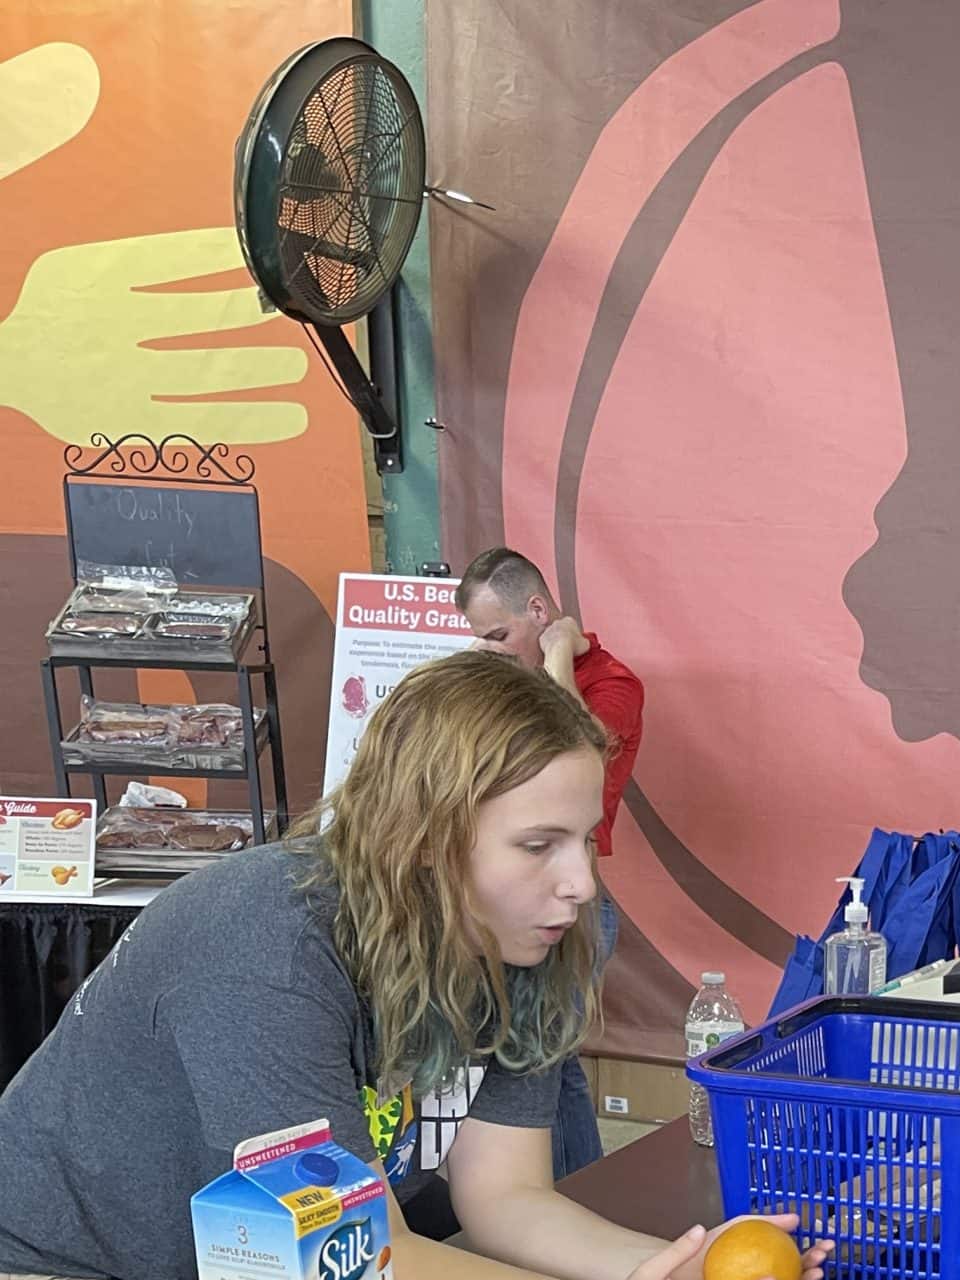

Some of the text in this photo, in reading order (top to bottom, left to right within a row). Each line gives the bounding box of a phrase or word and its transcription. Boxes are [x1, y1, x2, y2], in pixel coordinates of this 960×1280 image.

[384, 583, 420, 602] U.S.
[348, 605, 421, 630] Quality
[239, 1143, 296, 1169] UNSWEETENED
[295, 1190, 325, 1208] NEW
[237, 1225, 249, 1245] 3
[211, 1244, 280, 1263] SIMPLE REASONS
